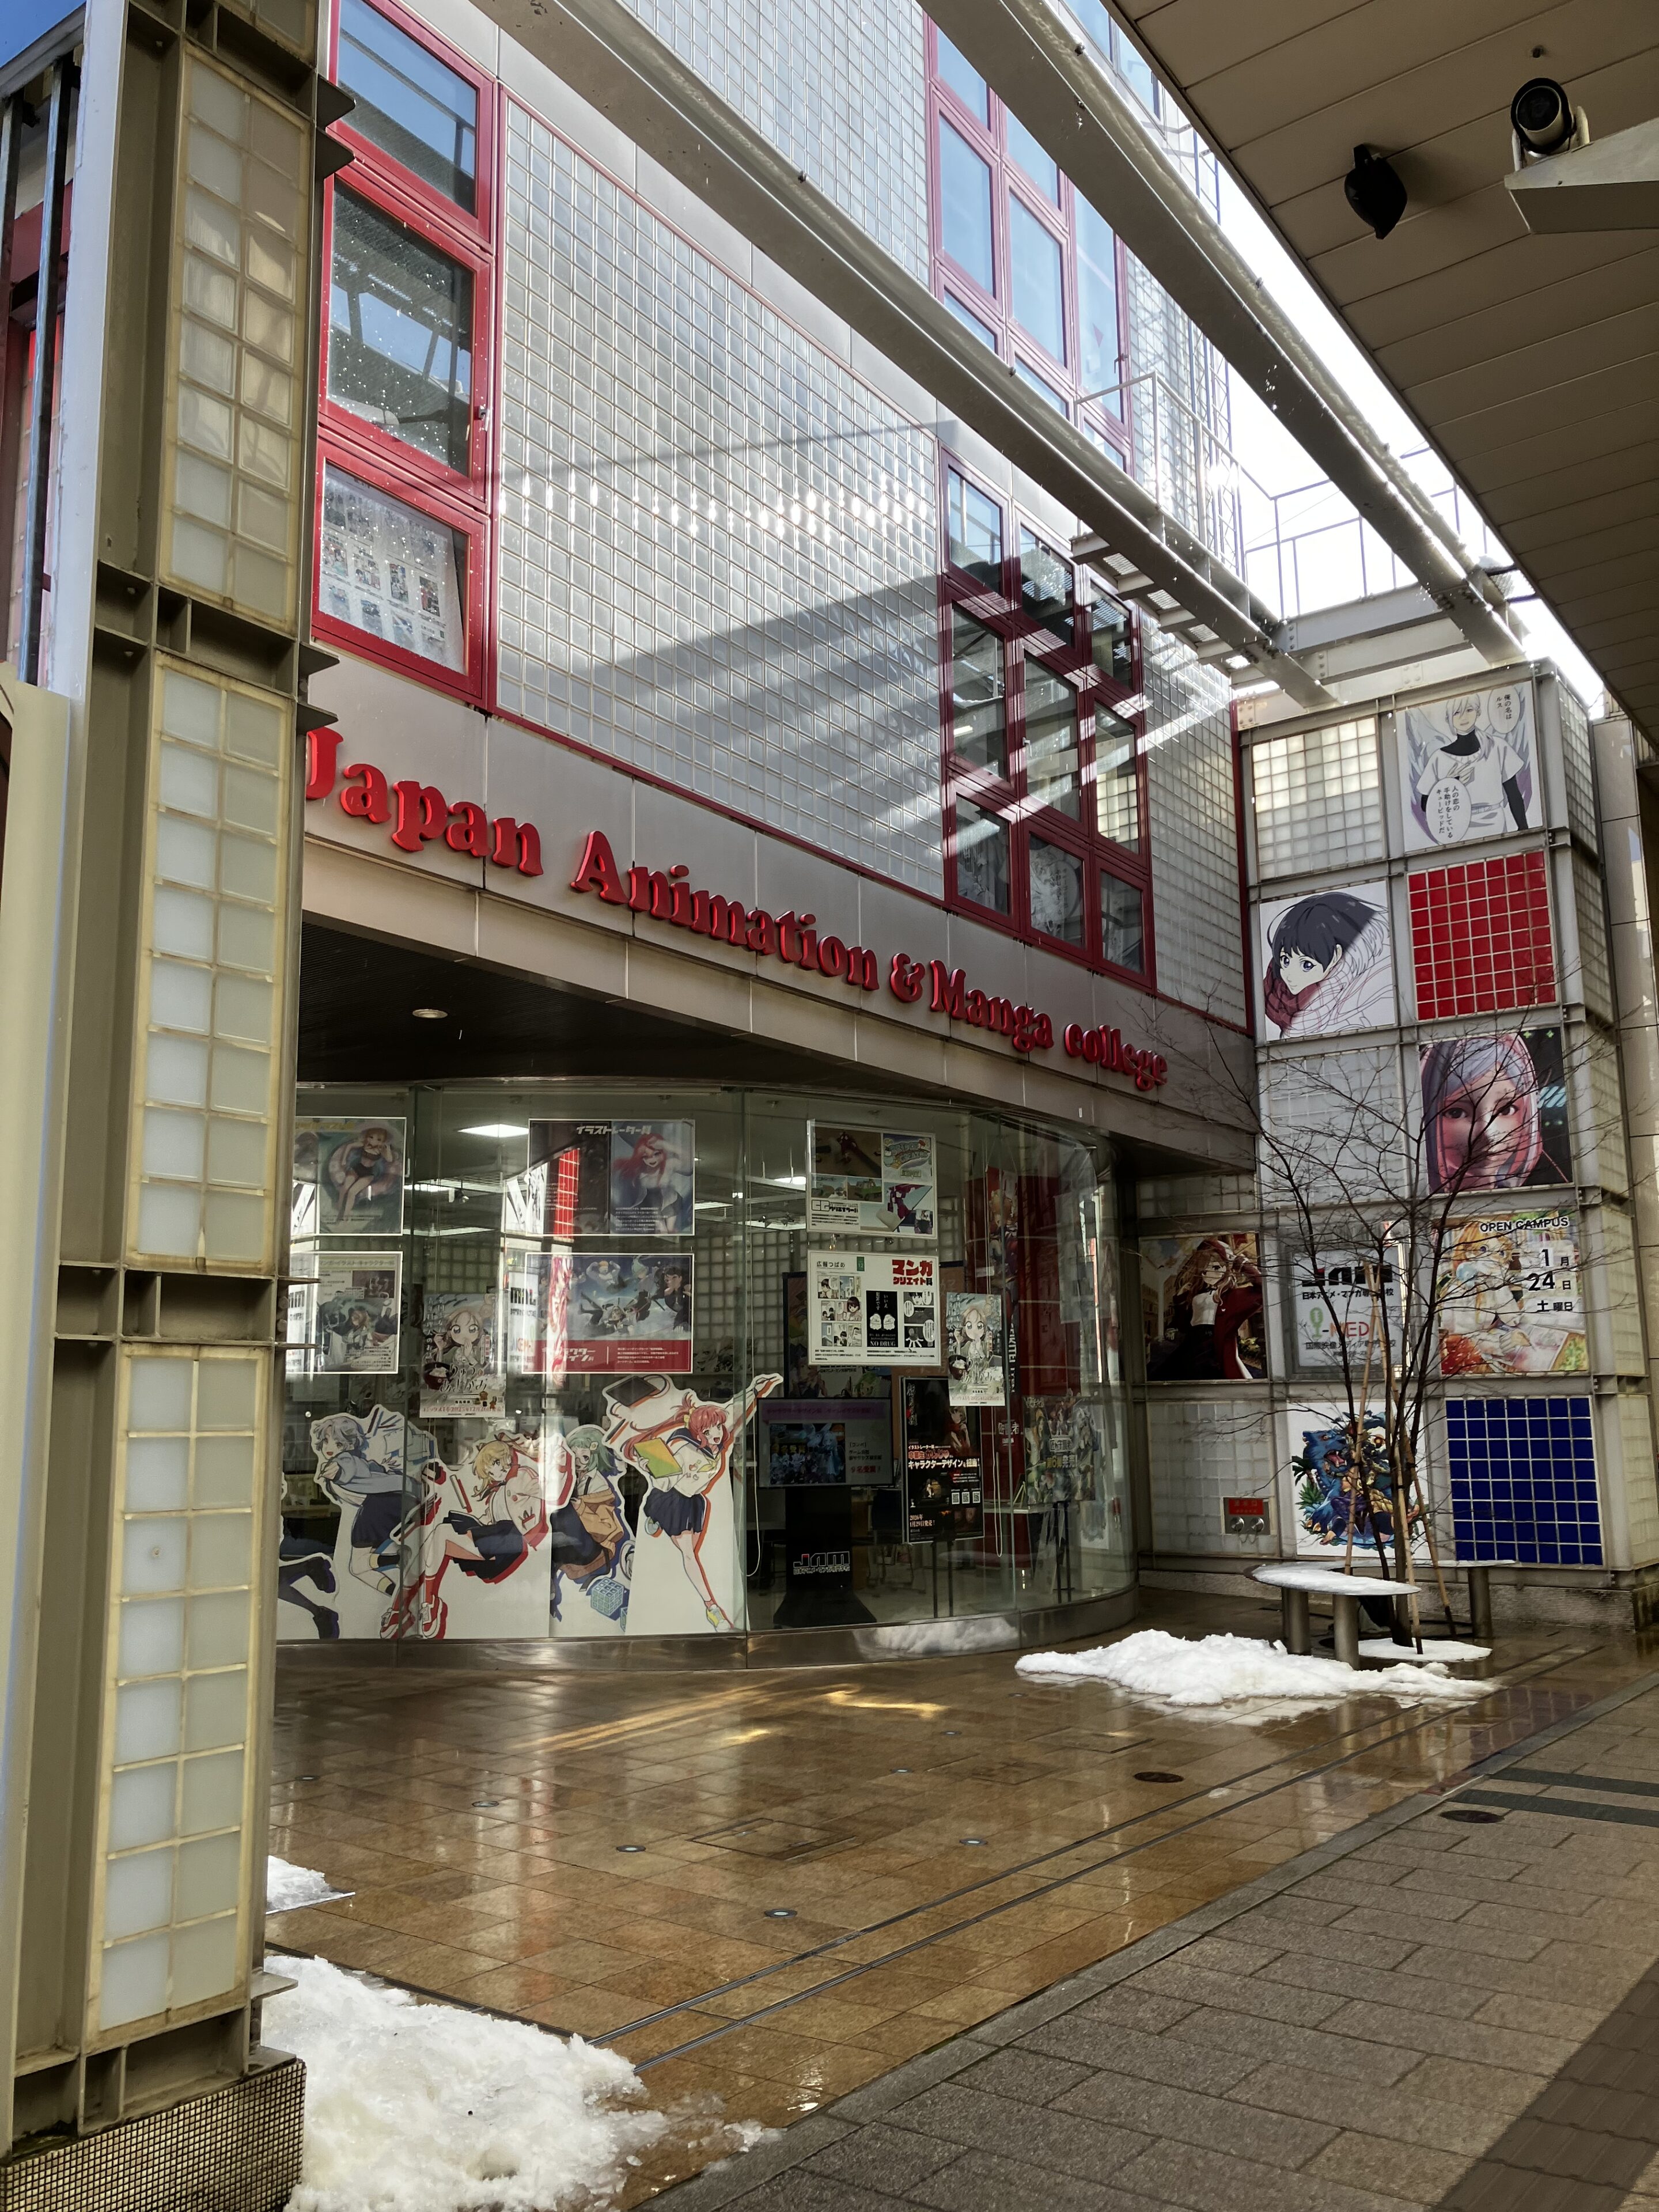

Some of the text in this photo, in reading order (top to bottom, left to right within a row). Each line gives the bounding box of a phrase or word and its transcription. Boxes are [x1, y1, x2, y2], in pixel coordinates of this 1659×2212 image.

[1503, 694, 1512, 719] 俺の名は
[1452, 785, 1460, 811] 人の恋の
[1436, 789, 1445, 834] キューピッドだ
[1444, 787, 1453, 838] 手助けをしている
[306, 726, 543, 876] Japan
[570, 831, 880, 991] Animation
[890, 953, 925, 1002] &
[929, 960, 1053, 1053] Manga
[1480, 1218, 1569, 1232] OPEN CAMPUS
[1541, 1249, 1569, 1266] 1 月
[892, 1259, 933, 1277] マンガ
[1529, 1271, 1571, 1291] 24 日
[1537, 1300, 1573, 1312] 土 曜日
[793, 1551, 850, 1568] JAM
